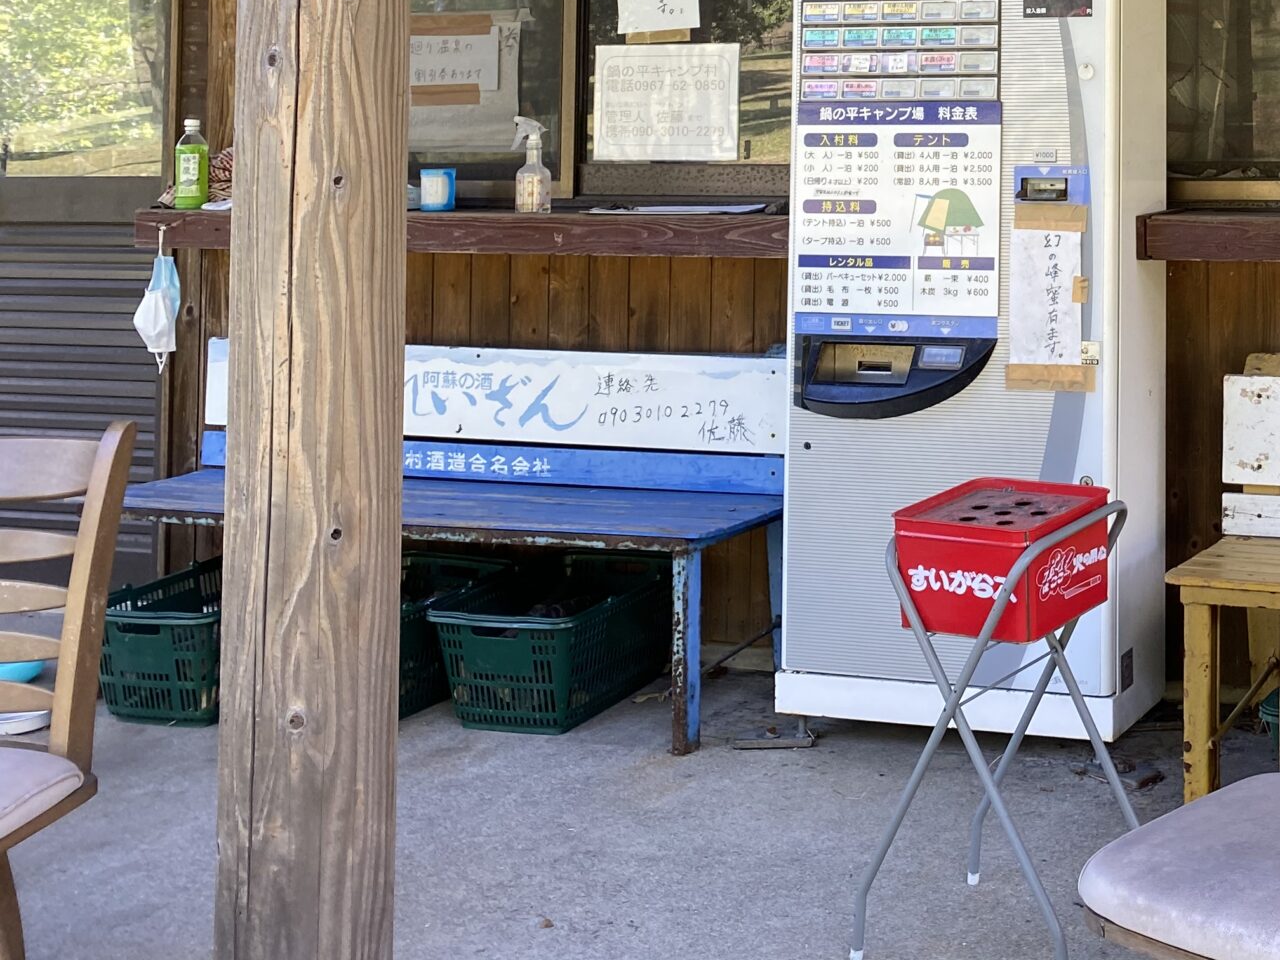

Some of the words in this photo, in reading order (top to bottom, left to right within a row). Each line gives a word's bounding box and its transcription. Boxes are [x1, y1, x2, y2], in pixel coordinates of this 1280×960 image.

[937, 106, 978, 121] 料金表
[913, 134, 952, 146] テント
[422, 370, 494, 390] 阿蘇の酒
